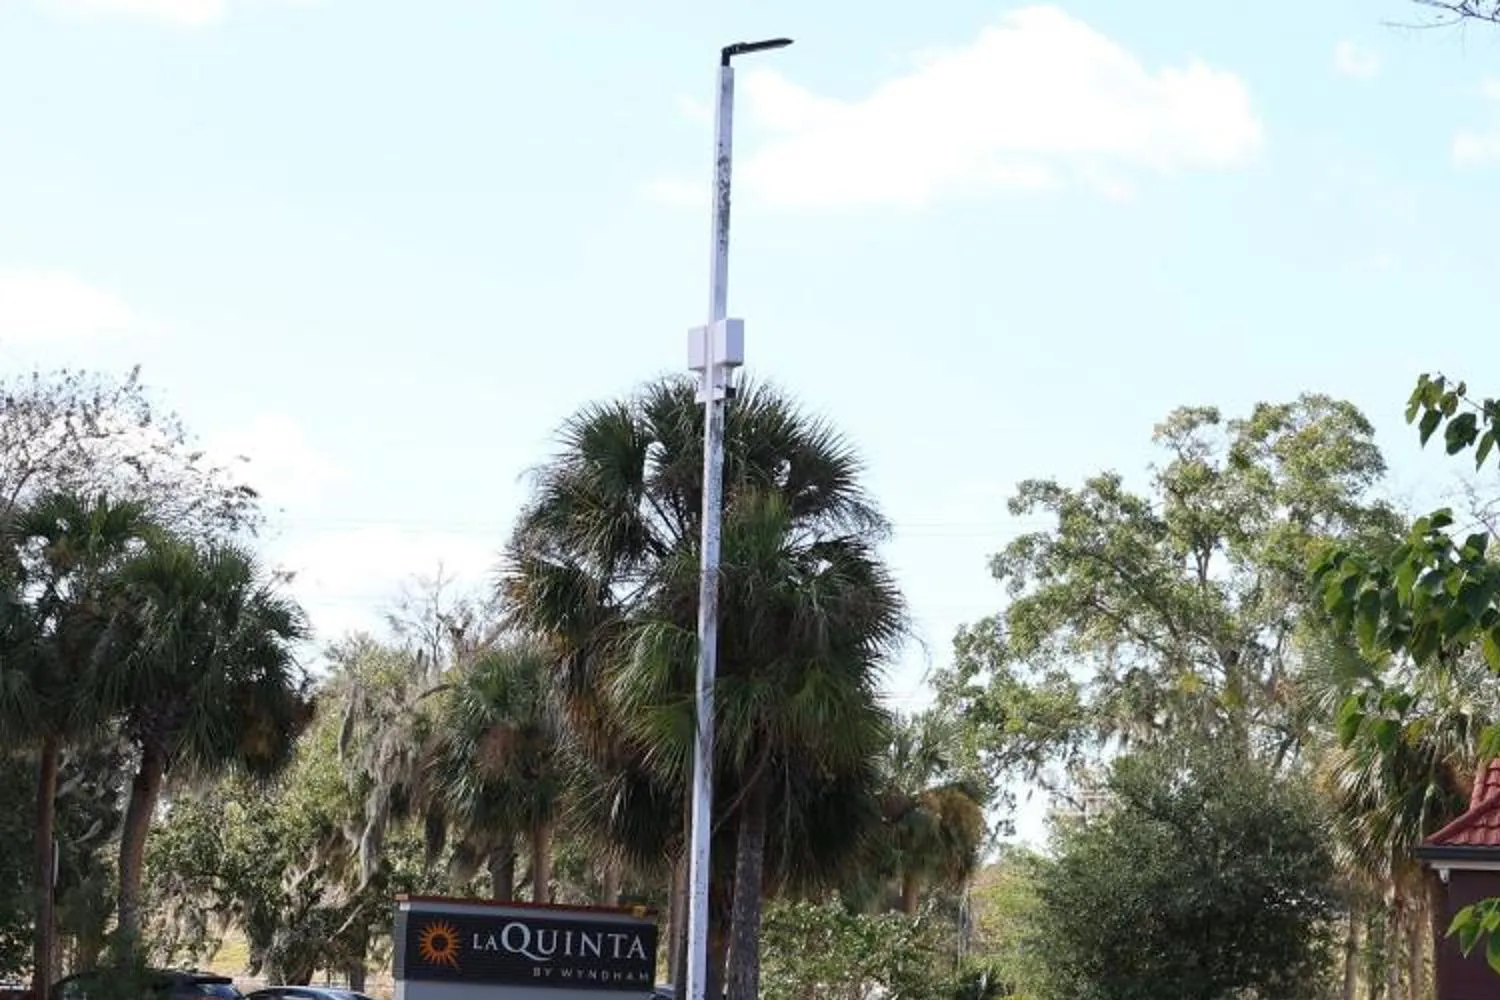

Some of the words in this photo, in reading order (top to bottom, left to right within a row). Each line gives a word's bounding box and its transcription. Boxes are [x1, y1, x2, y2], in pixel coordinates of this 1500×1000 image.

[473, 933, 498, 950] LA
[501, 922, 647, 961] QUINTA
[533, 967, 551, 977] BY
[561, 967, 649, 981] WYNDHAM
